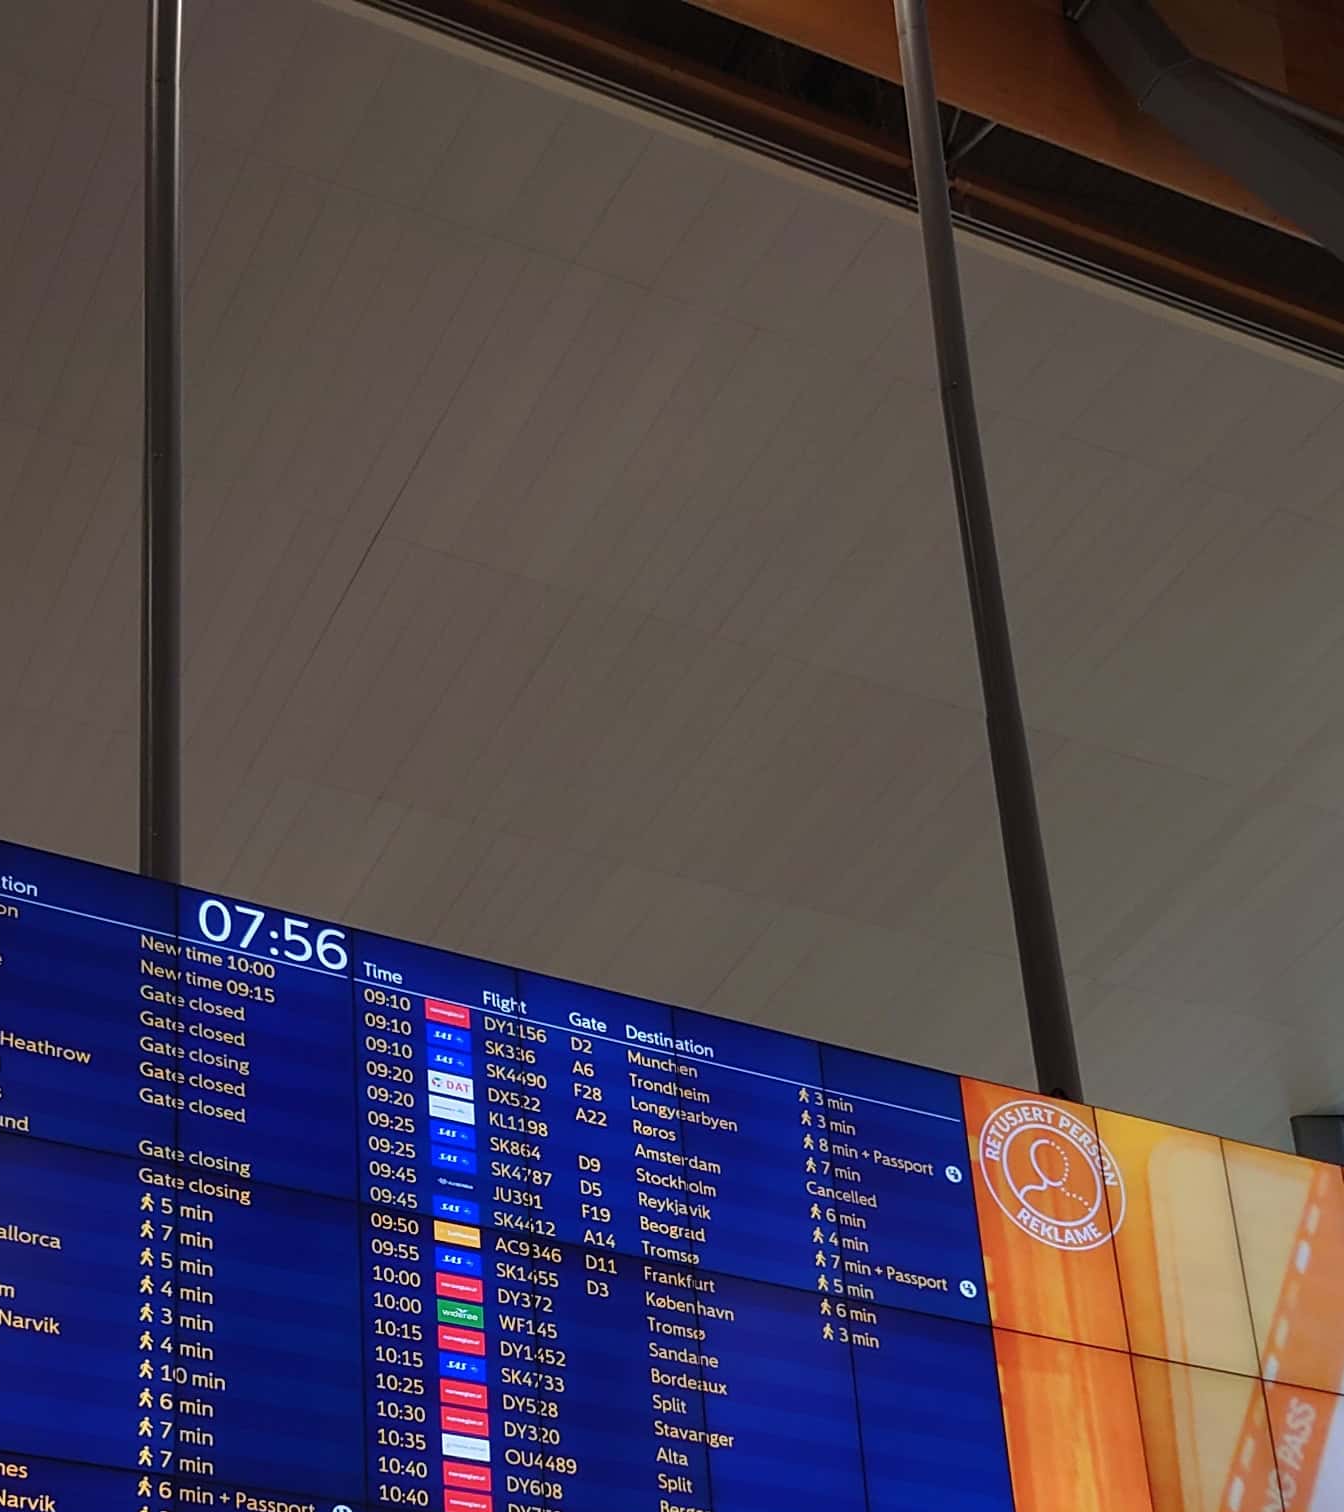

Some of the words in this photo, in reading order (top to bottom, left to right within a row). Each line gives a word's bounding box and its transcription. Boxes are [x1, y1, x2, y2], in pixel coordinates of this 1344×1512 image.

[198, 899, 348, 970] 07:56
[140, 959, 180, 981] New
[178, 971, 223, 992] time
[226, 979, 275, 1003] 09:15
[140, 984, 185, 1007] Gate
[188, 997, 246, 1022] closed
[363, 961, 403, 985] Time
[482, 990, 527, 1015] Flight
[568, 1011, 607, 1033] Gate
[625, 1024, 714, 1058] Destination
[0, 1030, 91, 1064] Heathrow
[366, 1060, 414, 1084] 09:20
[446, 1080, 471, 1093] DAT
[487, 1087, 541, 1113] DX522
[575, 1107, 608, 1127] A22
[632, 1119, 677, 1142] Røros
[821, 1160, 830, 1175] 7
[834, 1166, 861, 1182] min
[366, 1085, 415, 1108] 09:20
[489, 1111, 549, 1137] KL1198
[634, 1143, 721, 1175] Amsterdam
[806, 1180, 878, 1208] Cancelled
[985, 1106, 1055, 1162] RETUSJERT
[1058, 1115, 1119, 1187] PERSON
[369, 1160, 417, 1184] 09:45
[493, 1186, 544, 1210] JU391
[581, 1203, 611, 1223] F19
[639, 1215, 706, 1243] Beograd
[830, 1254, 841, 1269] 7
[844, 1259, 872, 1276] min
[886, 1265, 948, 1292] Passport
[1016, 1207, 1103, 1245] REKLAME
[373, 1291, 422, 1314] 10:00
[498, 1314, 558, 1339] WF145
[648, 1342, 719, 1369] Sandane
[377, 1428, 426, 1451] 10:35
[504, 1448, 577, 1475] OU4489
[657, 1473, 693, 1494] Split
[1276, 1397, 1317, 1472] PASS
[158, 1481, 172, 1499] 6
[179, 1486, 214, 1505] min
